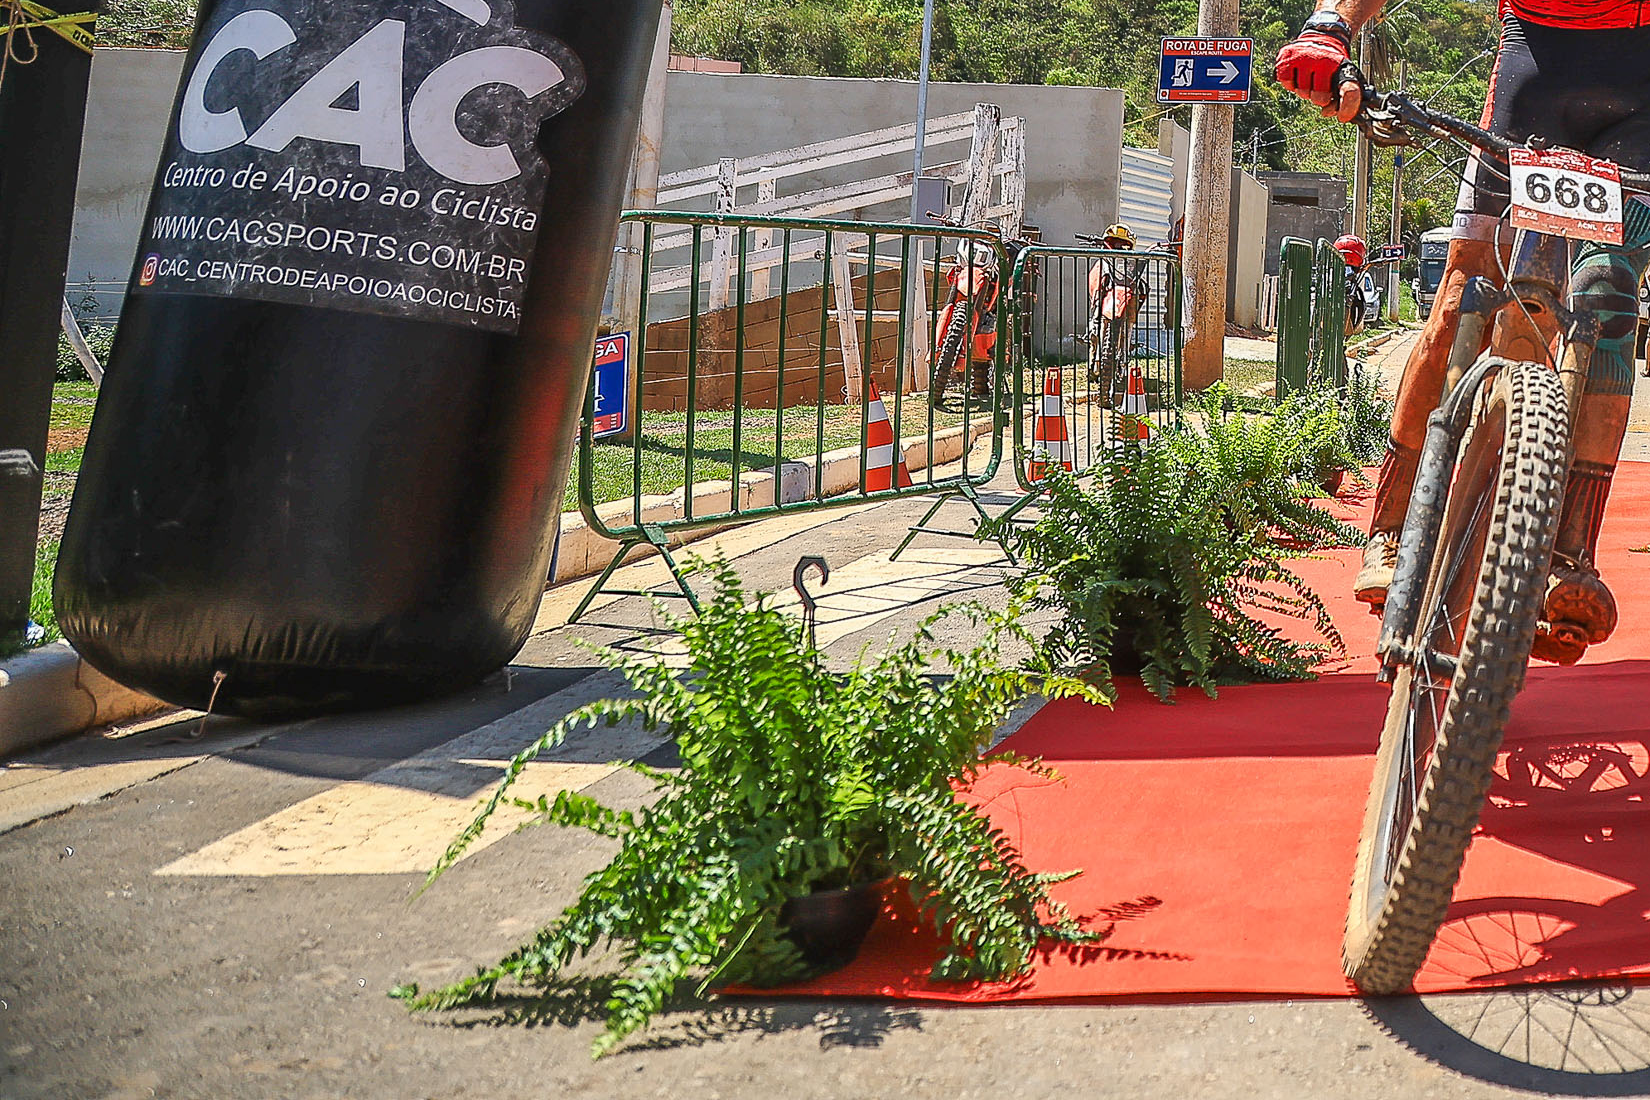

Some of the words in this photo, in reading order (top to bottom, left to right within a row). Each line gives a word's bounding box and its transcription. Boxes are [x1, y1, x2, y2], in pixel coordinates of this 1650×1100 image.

[1166, 40, 1196, 51] ROTA
[1199, 41, 1213, 51] DE
[1217, 41, 1248, 51] FUGA
[178, 8, 566, 186] CAC
[163, 161, 226, 190] Centro
[230, 163, 266, 191] de
[272, 166, 370, 205] Apoio
[379, 186, 421, 211] ao
[431, 187, 539, 232] Ciclista
[1525, 172, 1609, 214] 668
[151, 216, 527, 284] WWW.CACSPORTS.COM.BR
